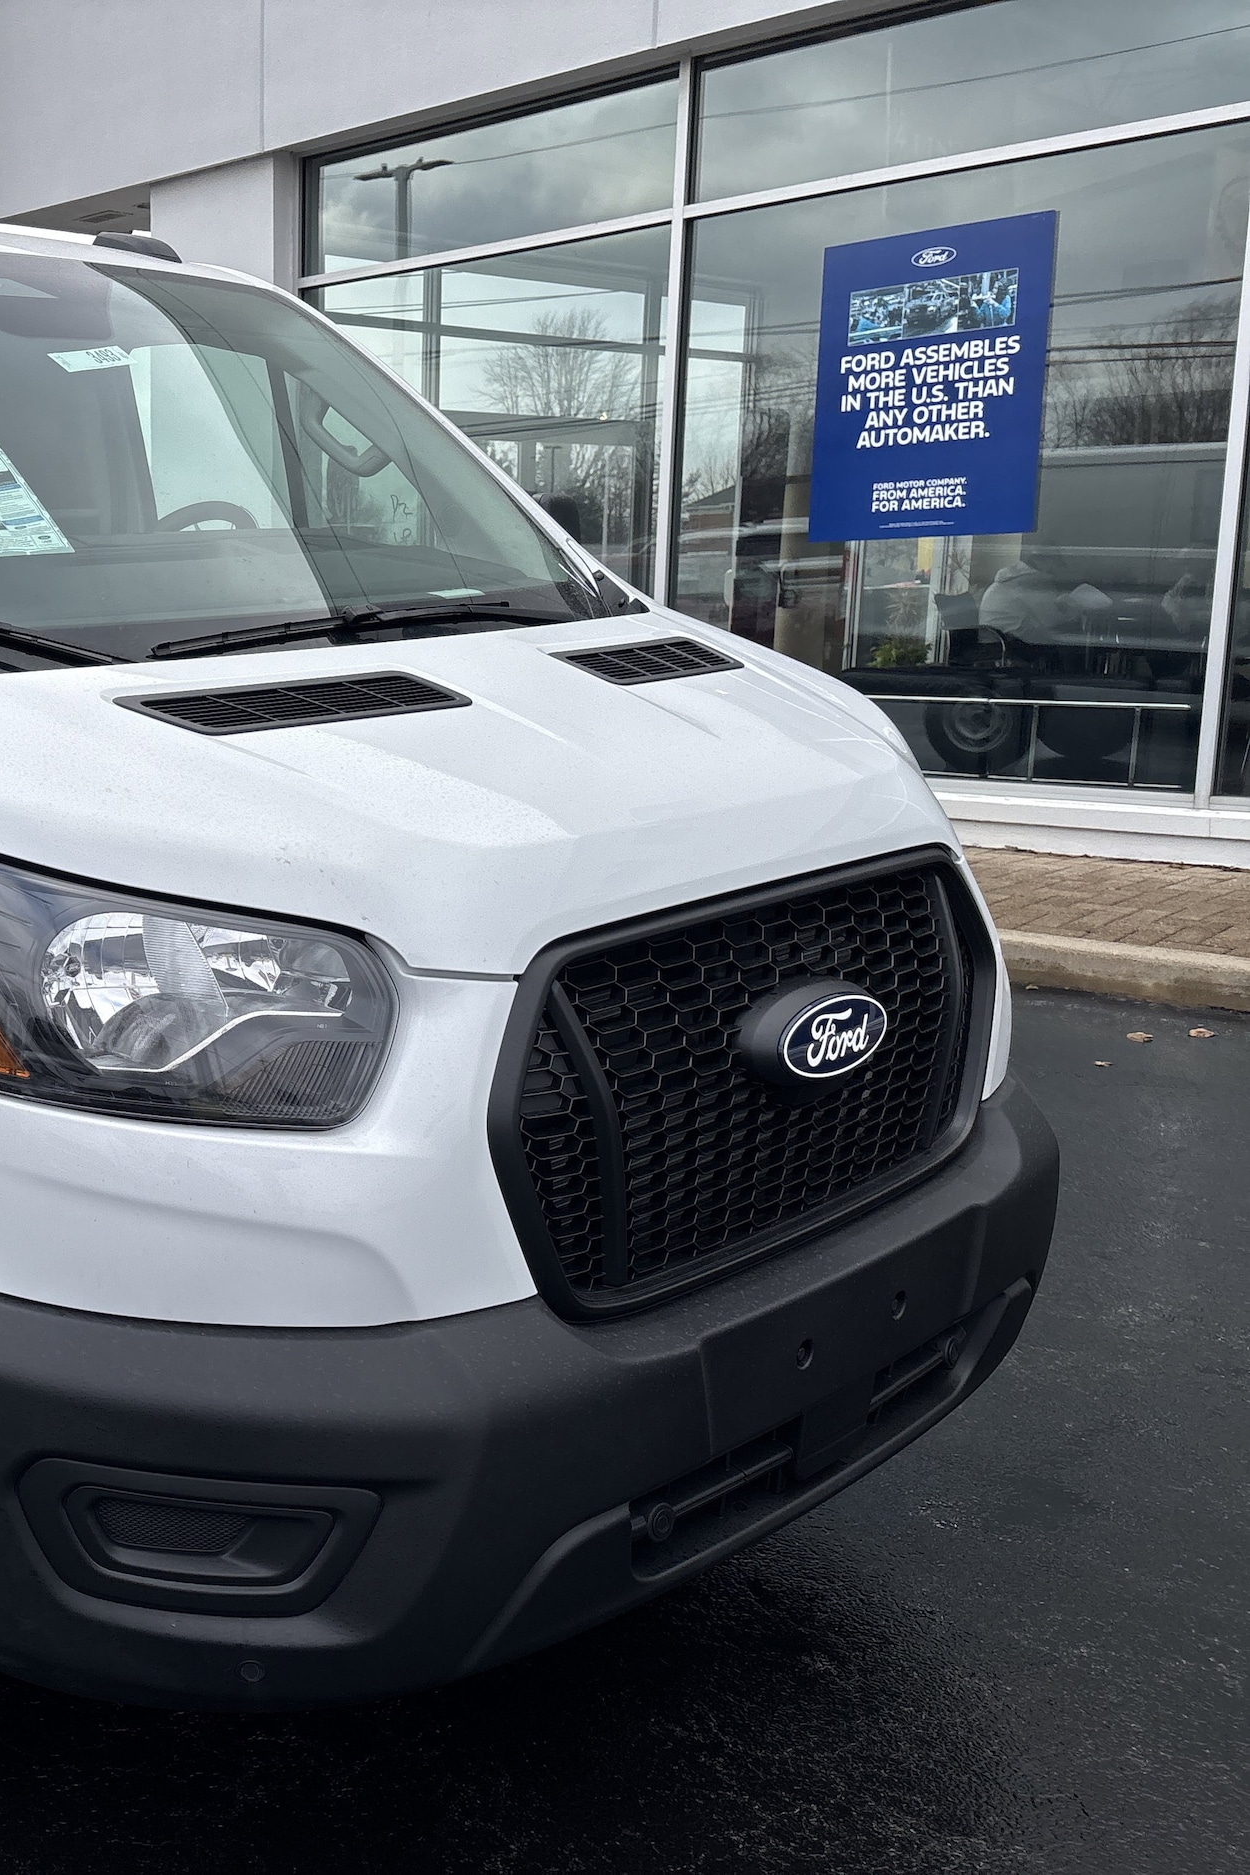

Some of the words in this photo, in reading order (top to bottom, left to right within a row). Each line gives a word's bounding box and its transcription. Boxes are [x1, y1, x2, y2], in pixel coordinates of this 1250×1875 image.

[918, 248, 949, 266] Ford
[840, 350, 896, 375] FORD
[899, 335, 1021, 367] ASSEMBLES
[847, 368, 907, 393] MORE
[911, 357, 1010, 385] VEHICLES
[840, 393, 861, 412] IN
[866, 388, 907, 409] THE
[911, 384, 949, 405] U.S.
[954, 376, 1015, 400] THAN
[864, 407, 909, 429] ANY
[912, 400, 985, 424] OTHER
[855, 420, 991, 450] AUTOMAKER.
[872, 481, 895, 491] FORD
[895, 479, 925, 489] MOTOR
[926, 476, 968, 487] COMPANY.
[872, 488, 907, 501] FROM
[908, 484, 967, 499] AMERICA.
[871, 499, 899, 513] FOR
[900, 495, 966, 512] AMERICA.
[806, 1007, 870, 1068] Ford
